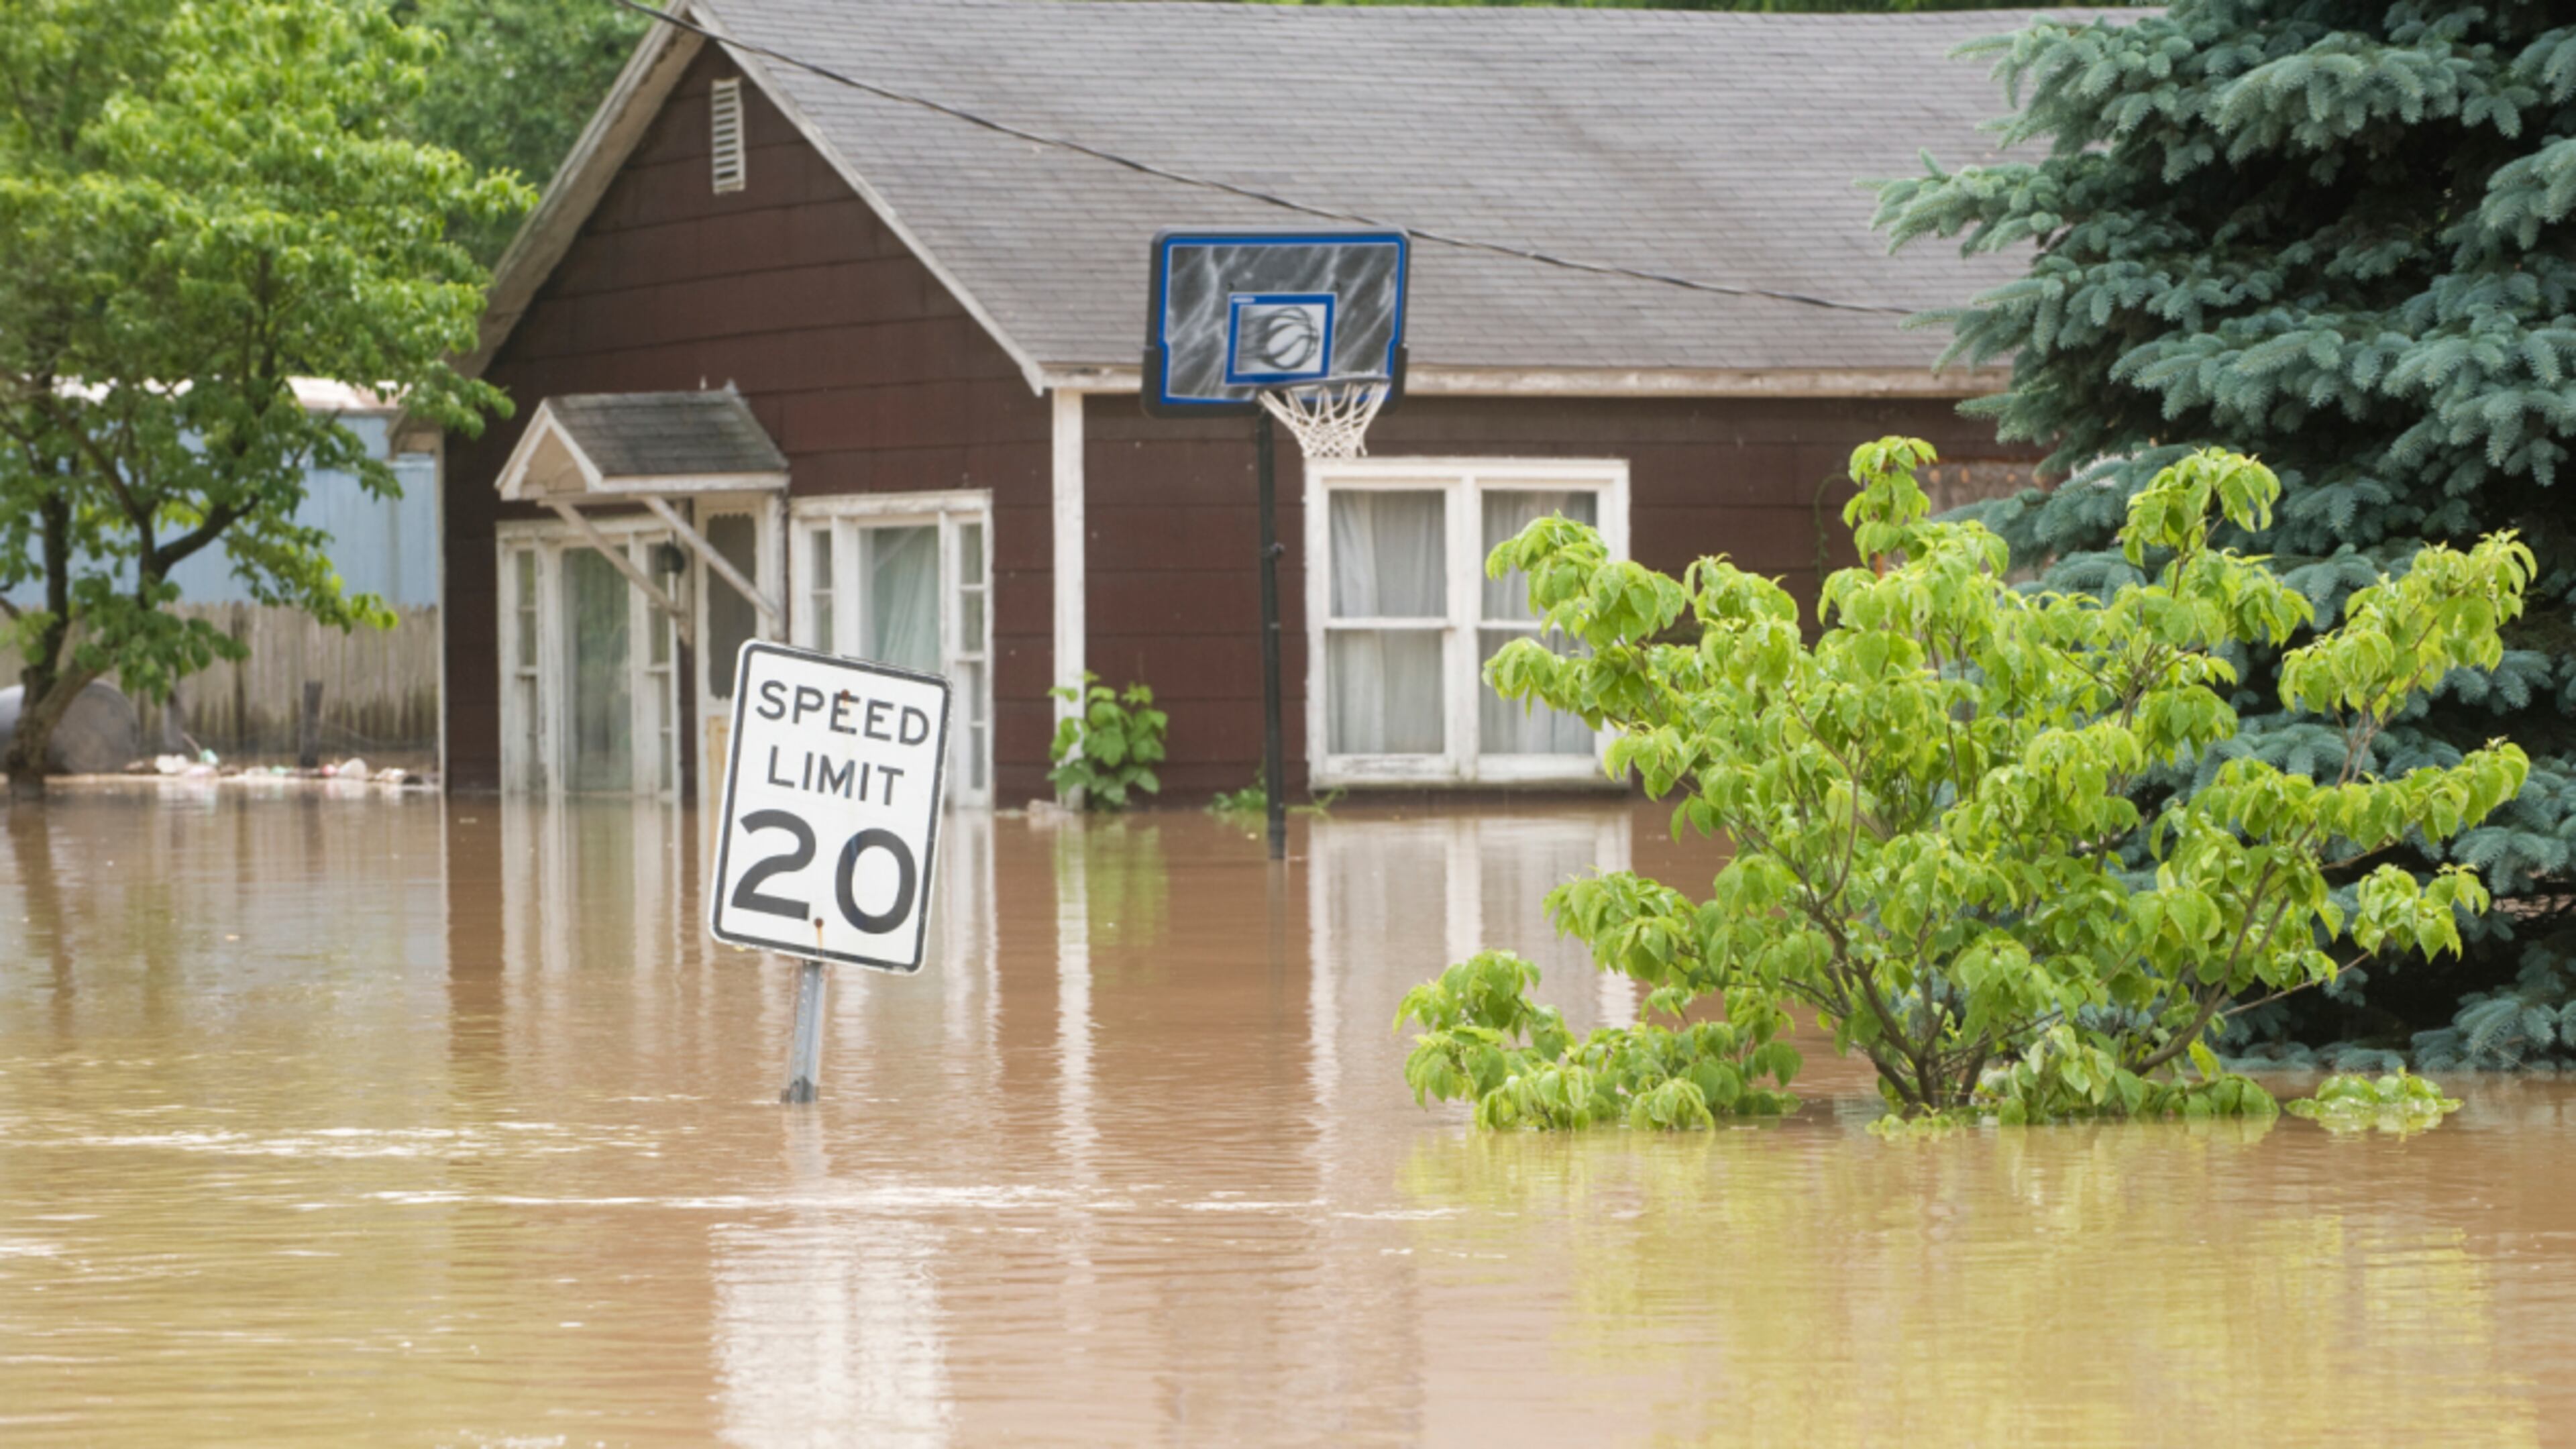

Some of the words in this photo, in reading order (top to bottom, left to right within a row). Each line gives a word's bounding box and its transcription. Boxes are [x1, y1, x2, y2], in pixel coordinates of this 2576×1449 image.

[756, 680, 930, 746] SPEED
[767, 745, 904, 806] LIMIT
[731, 809, 916, 934] 20
